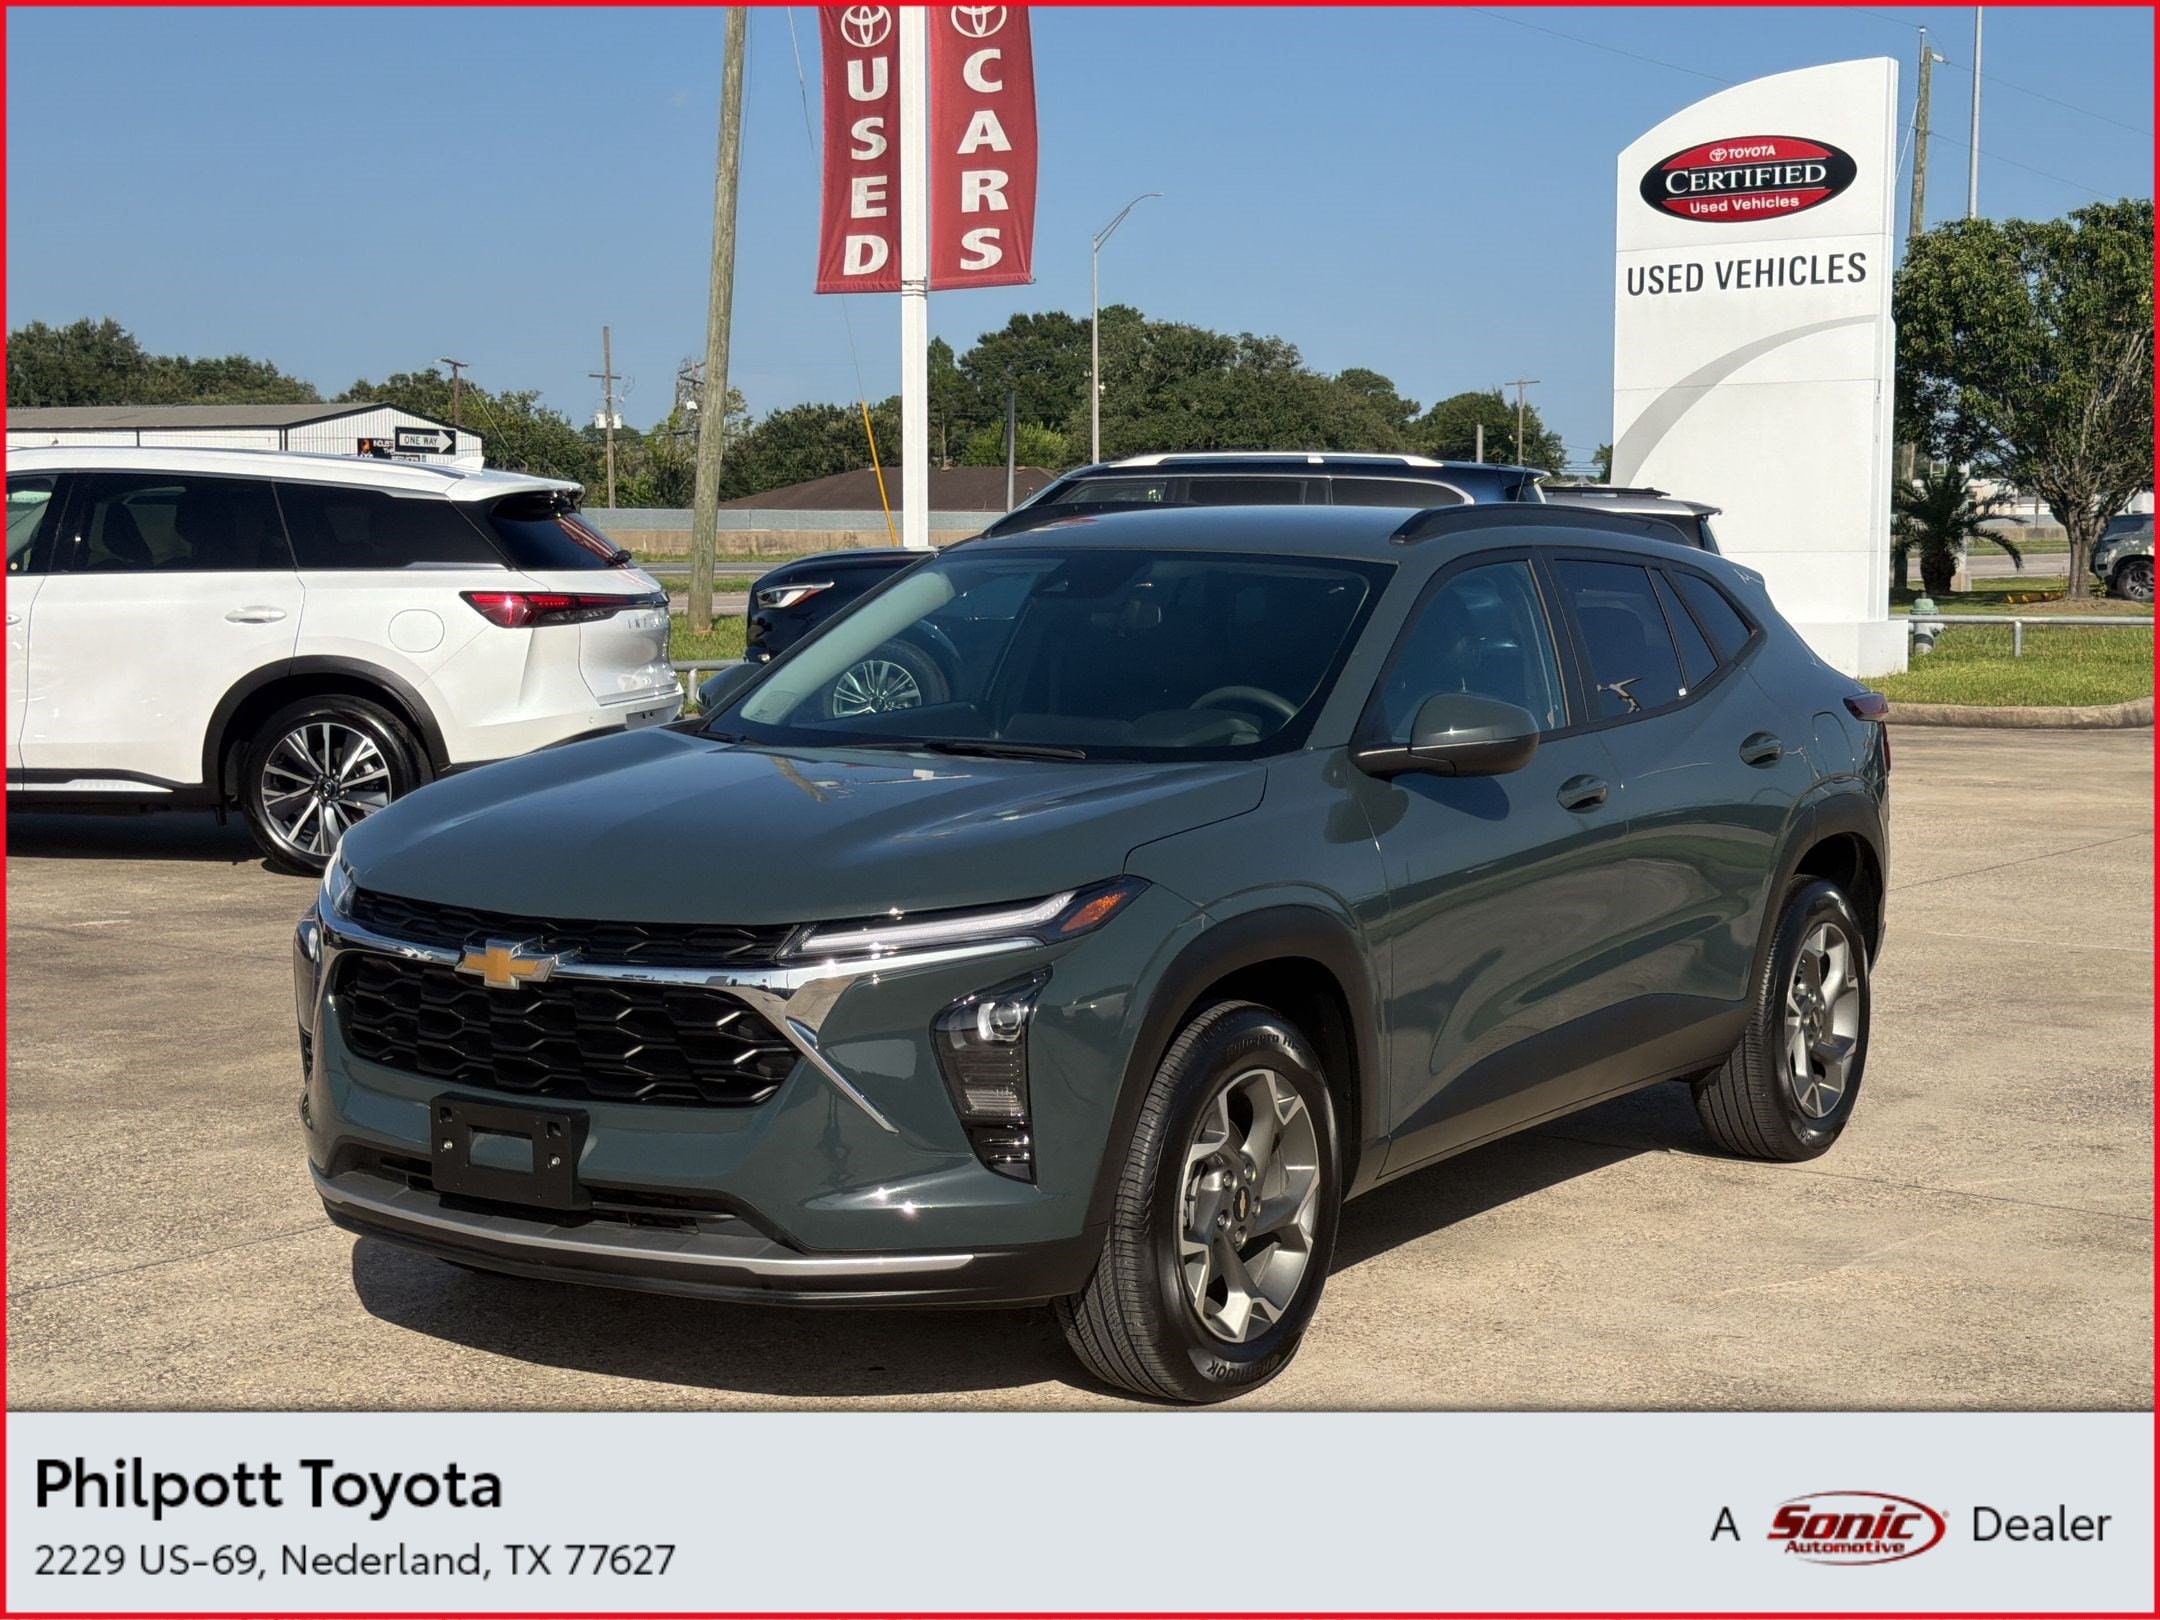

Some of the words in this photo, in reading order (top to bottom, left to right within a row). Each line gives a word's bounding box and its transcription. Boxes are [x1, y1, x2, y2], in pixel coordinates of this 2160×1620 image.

[843, 56, 889, 276] USED
[956, 48, 1013, 271] CARS
[1728, 145, 1776, 159] TOYOTA
[1665, 164, 1827, 194] CERTIFIED
[1689, 200, 1729, 214] Used
[1732, 195, 1800, 211] Vehicles
[1627, 262, 1704, 296] USED
[1714, 252, 1867, 291] VEHICLES
[404, 435, 420, 445] ONE
[423, 436, 438, 446] WAY
